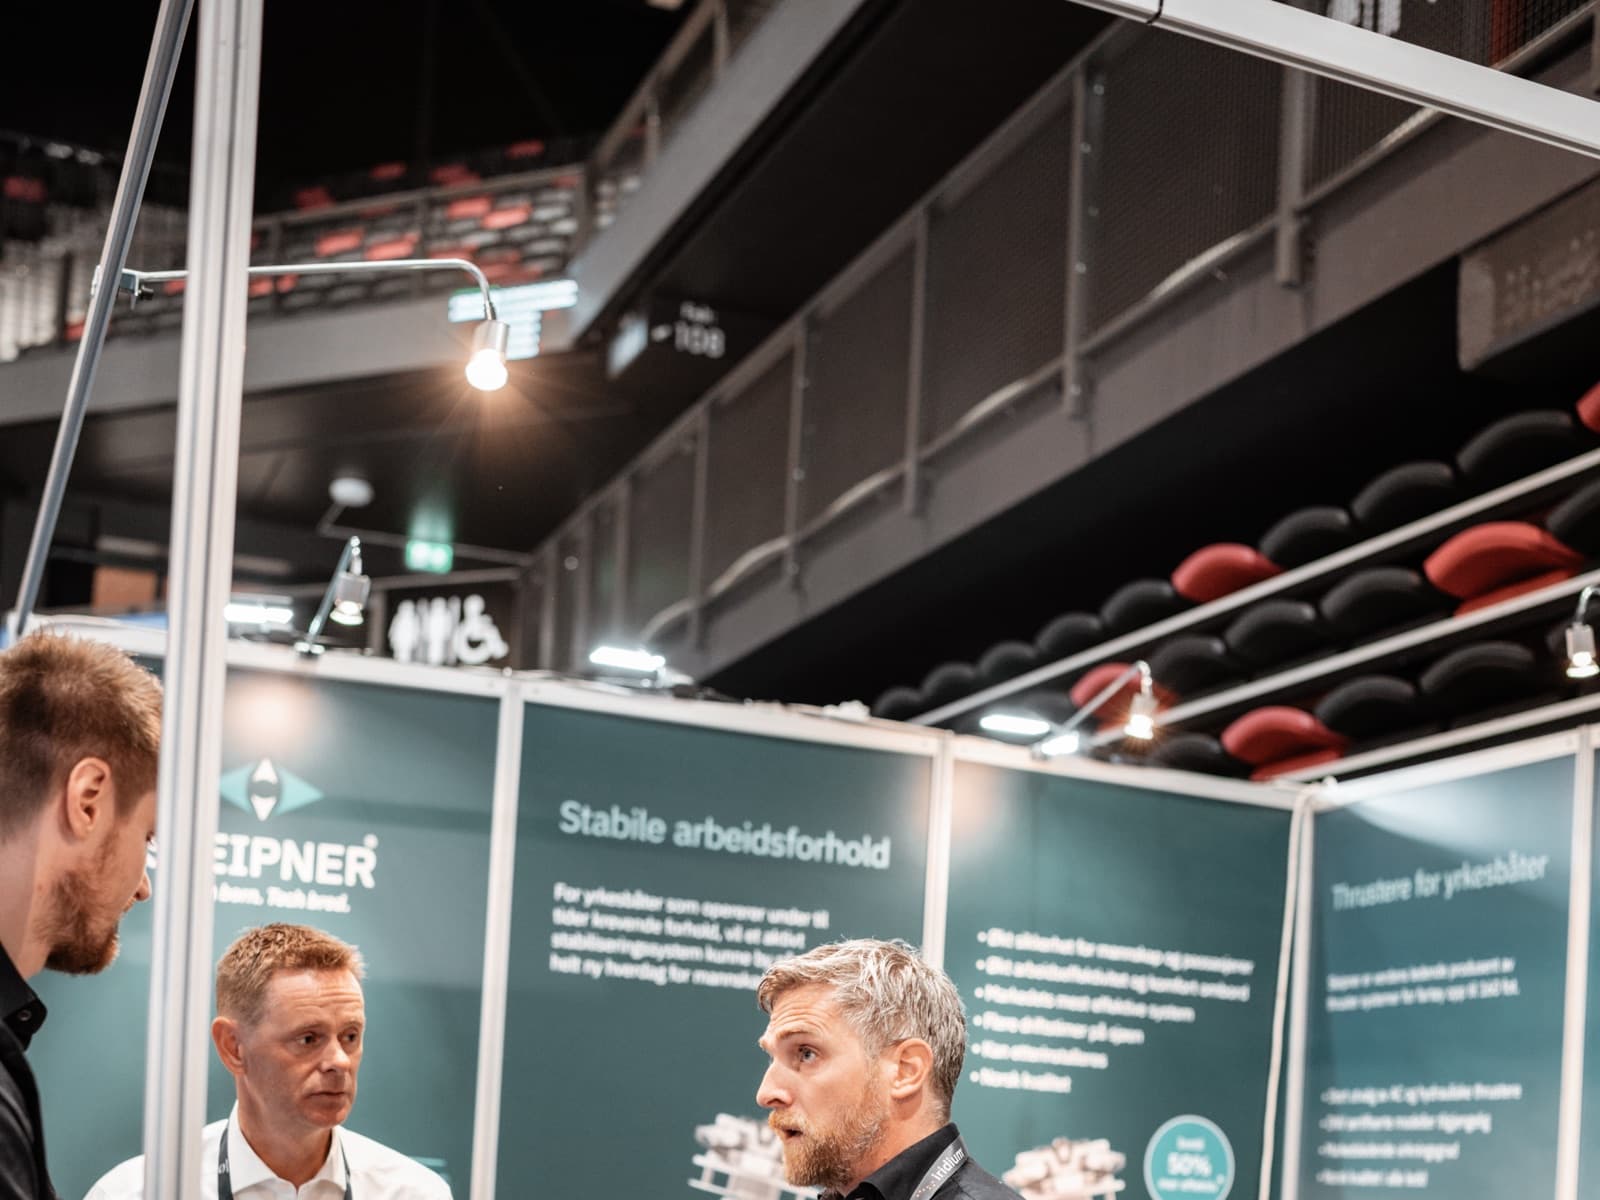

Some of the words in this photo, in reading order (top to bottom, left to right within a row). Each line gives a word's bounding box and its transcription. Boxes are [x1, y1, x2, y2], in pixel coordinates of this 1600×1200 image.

[212, 832, 377, 889] EIPNER
[559, 800, 667, 844] Stabile
[673, 815, 892, 870] arbeidsforhold
